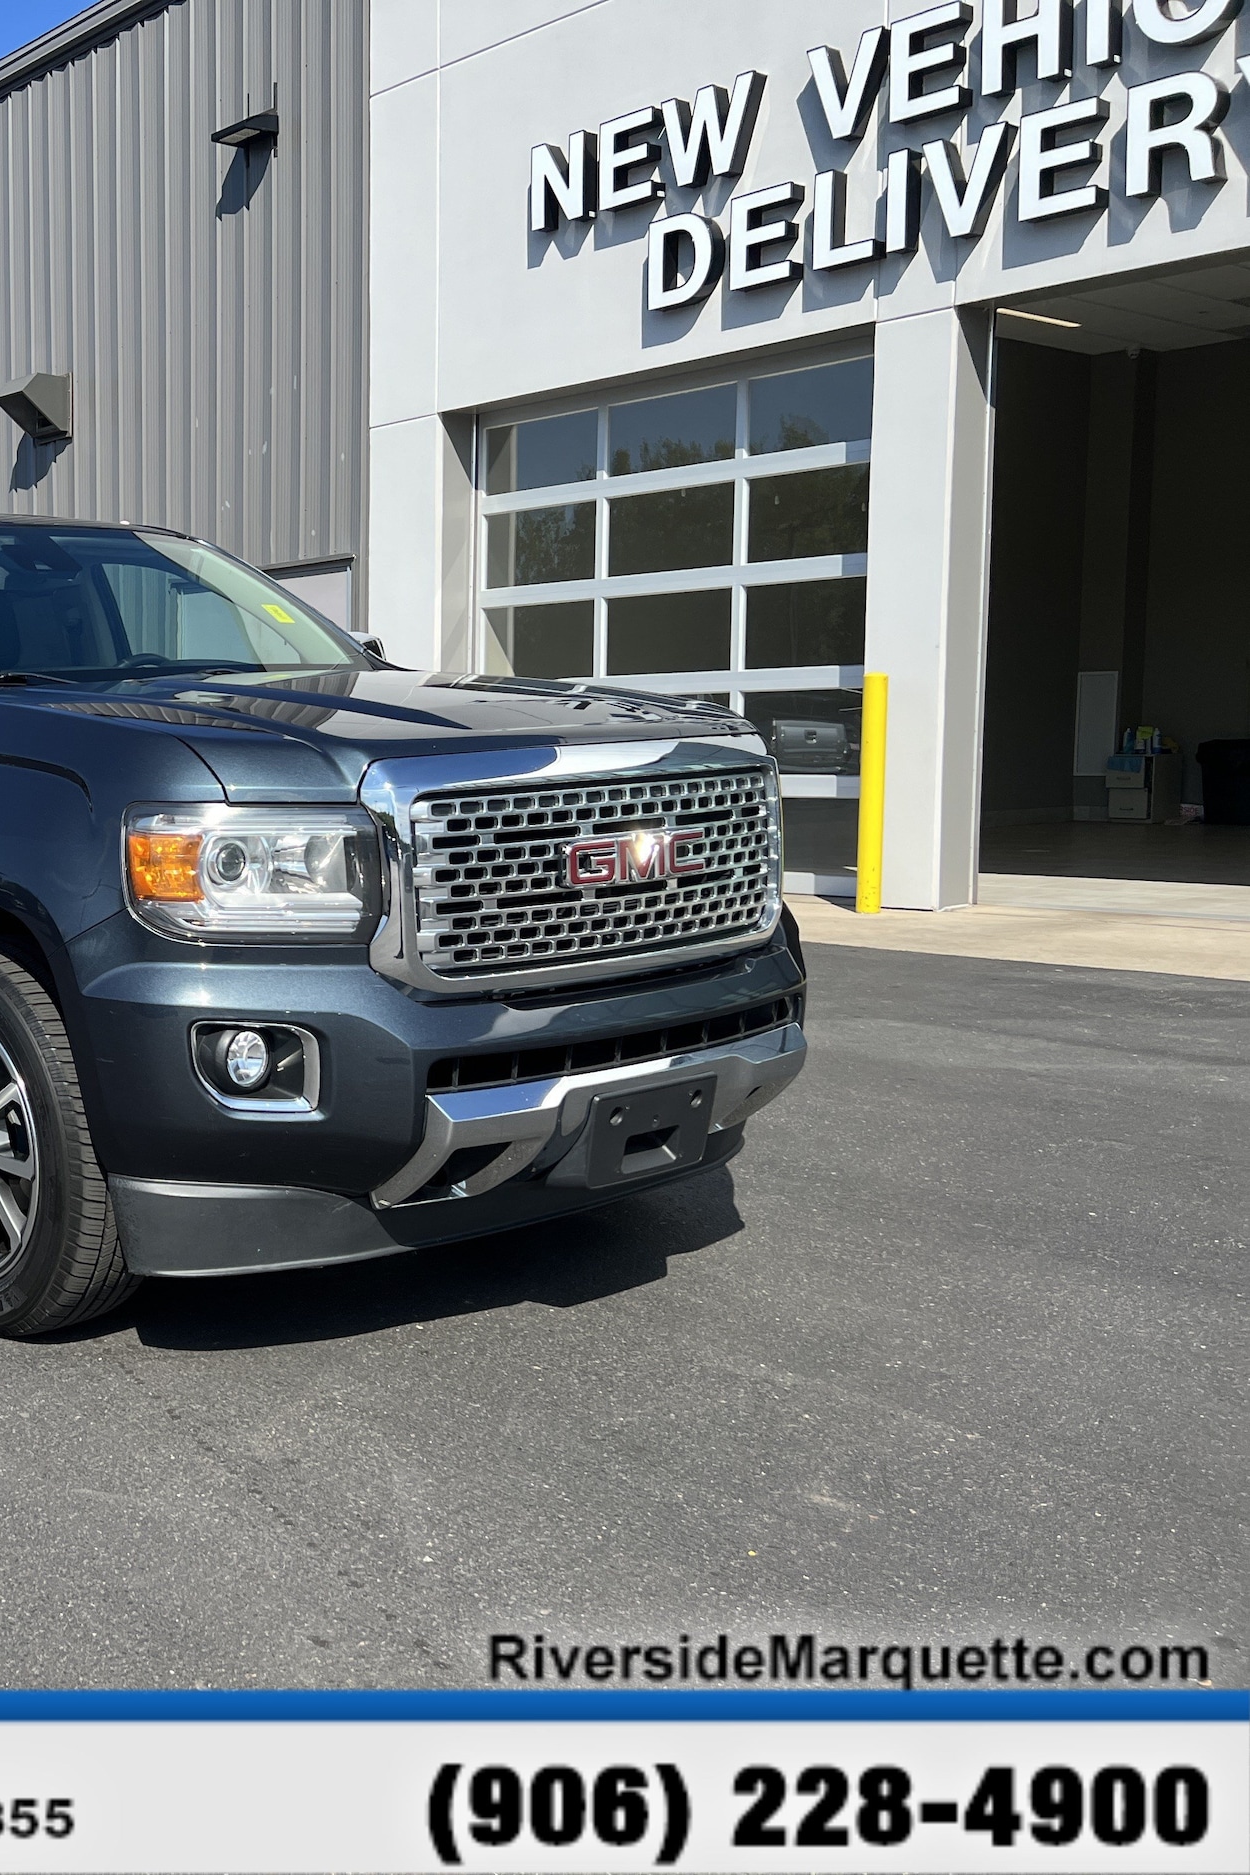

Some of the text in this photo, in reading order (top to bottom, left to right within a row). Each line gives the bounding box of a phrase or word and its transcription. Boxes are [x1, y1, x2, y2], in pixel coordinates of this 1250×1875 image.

[530, 70, 766, 231] NEW
[648, 54, 1250, 311] DELIVER
[567, 829, 704, 887] GMC
